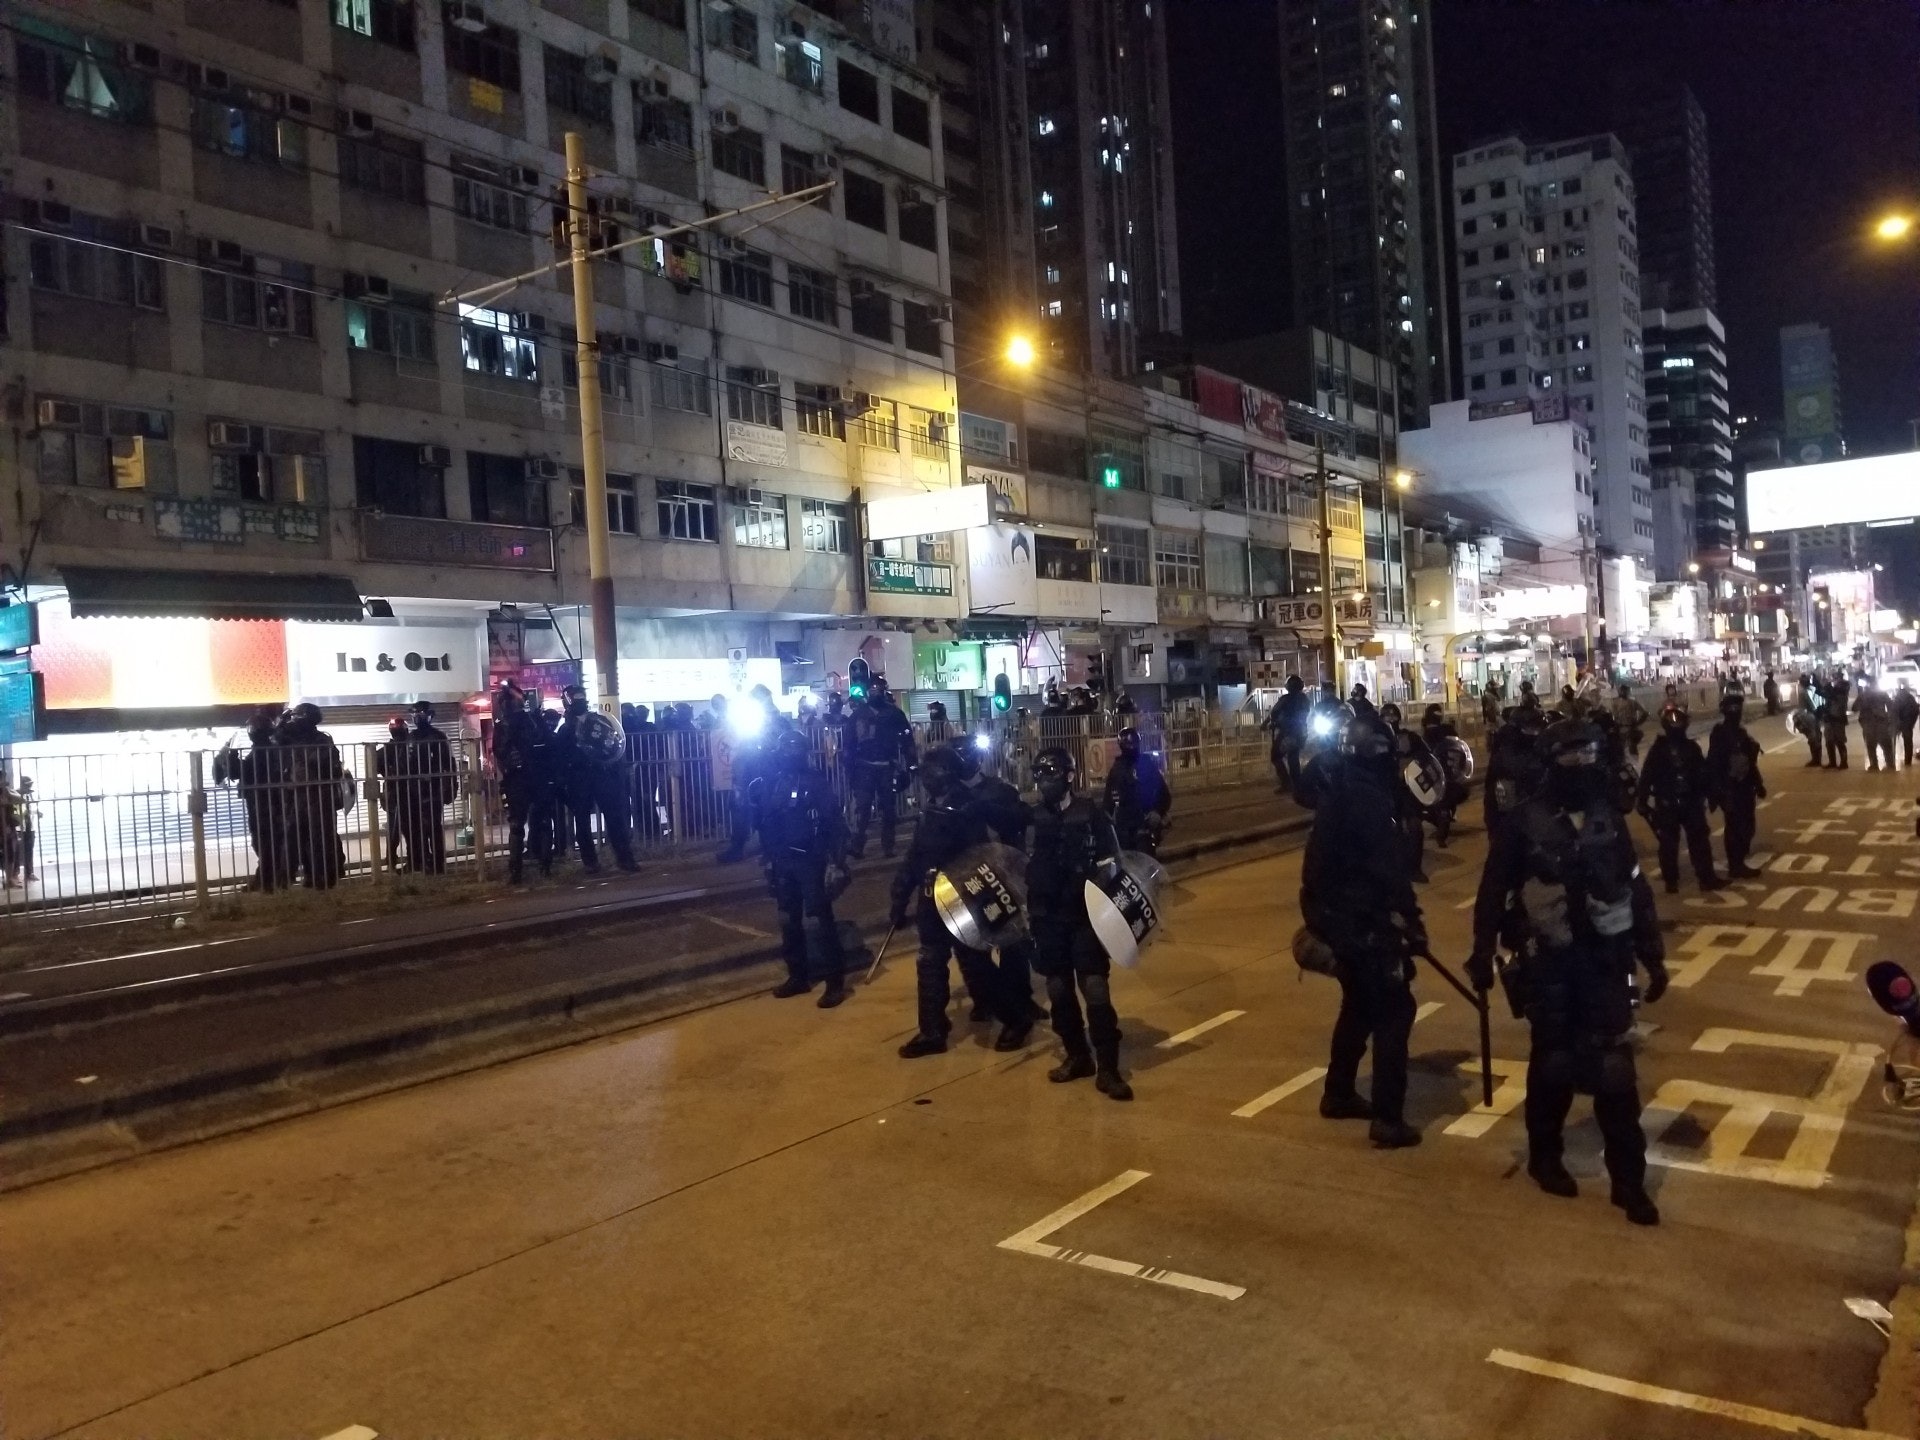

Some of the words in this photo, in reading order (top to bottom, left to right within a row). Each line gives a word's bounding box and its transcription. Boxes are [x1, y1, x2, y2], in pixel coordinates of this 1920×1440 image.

[336, 651, 367, 673] In
[376, 651, 397, 673] &
[403, 651, 451, 673] Out
[977, 863, 1017, 915] POLICE
[1120, 875, 1157, 929] POLICE
[1683, 883, 1918, 918] BUS
